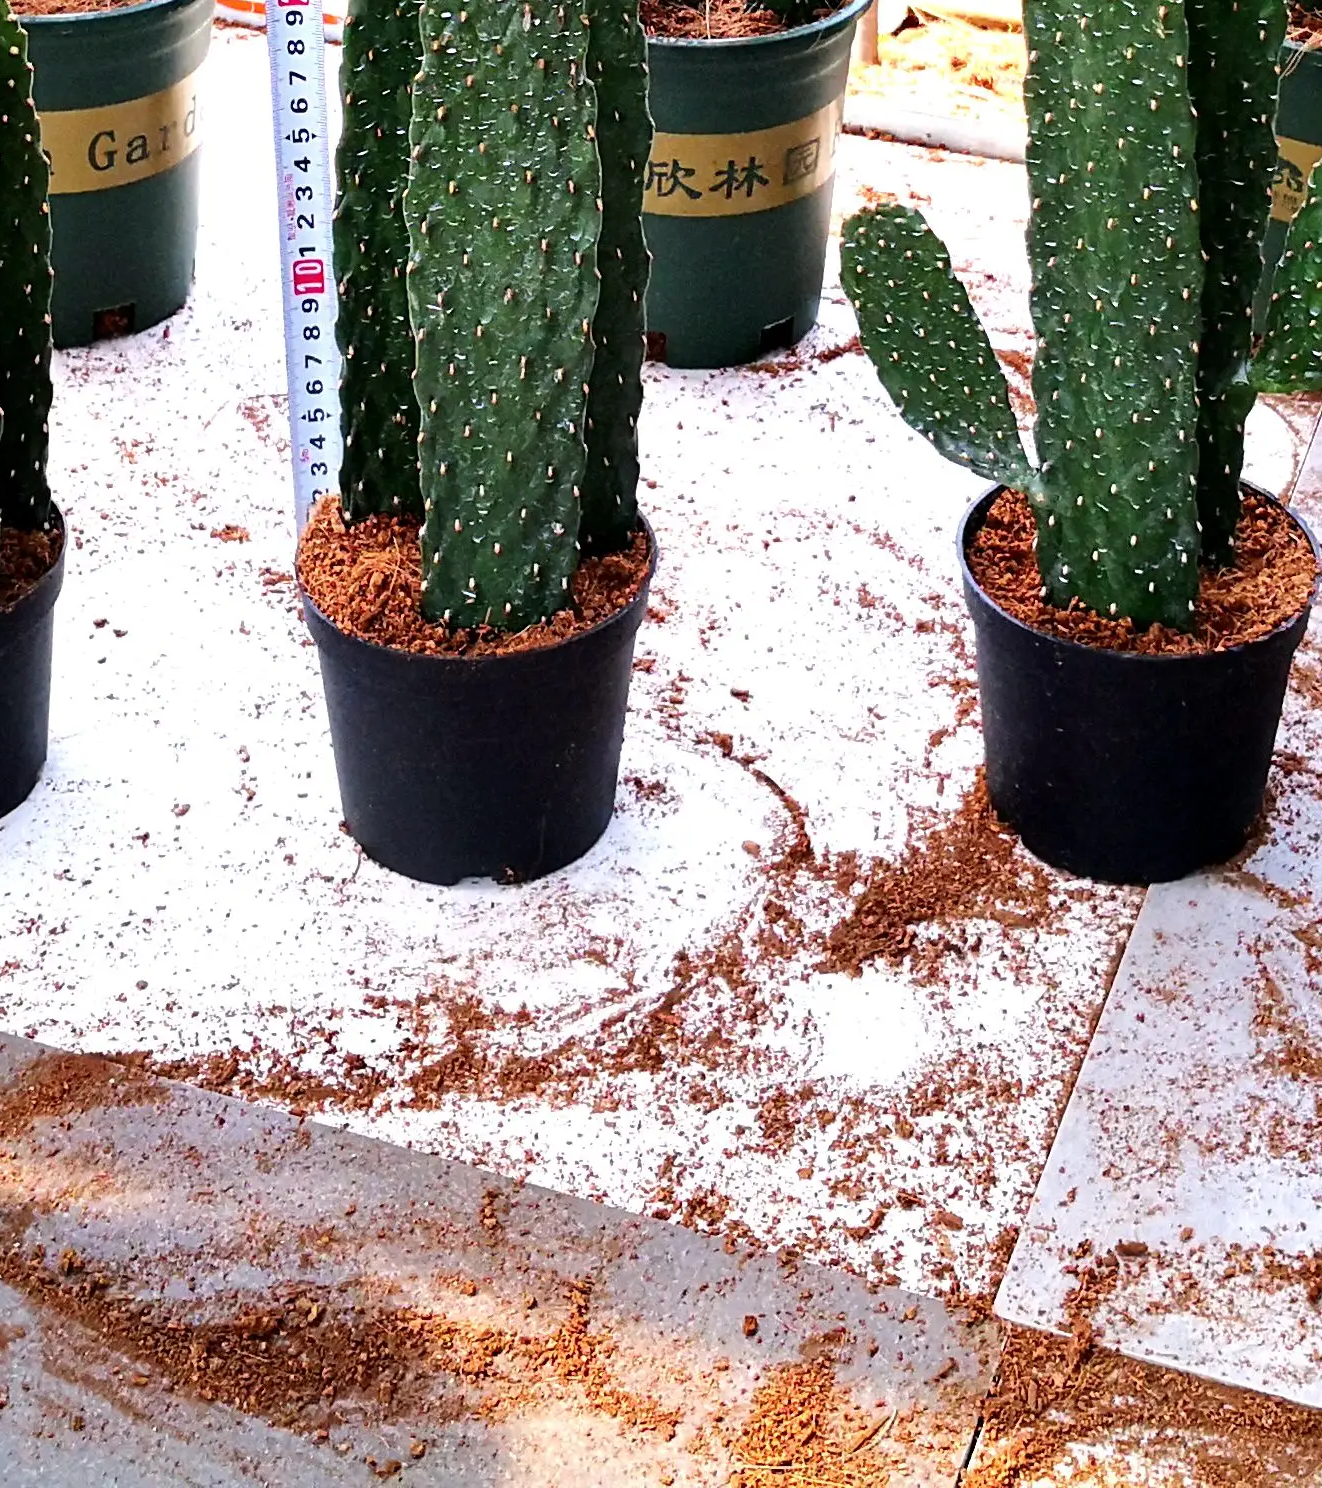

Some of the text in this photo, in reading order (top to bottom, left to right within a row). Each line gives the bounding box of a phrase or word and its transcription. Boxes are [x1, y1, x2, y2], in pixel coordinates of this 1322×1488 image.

[285, 10, 304, 27] 9
[286, 39, 305, 56] 8
[288, 70, 307, 86] 7
[290, 97, 309, 114] 6
[291, 128, 310, 144] 5
[293, 156, 311, 173] 4
[295, 185, 313, 201] 3
[296, 213, 315, 230] 2
[298, 246, 316, 258] 1
[294, 263, 324, 292] 10
[301, 298, 319, 313] 9
[302, 325, 321, 341] 8
[304, 354, 322, 369] 7
[305, 379, 324, 395] 6
[307, 408, 325, 423] 5
[309, 434, 326, 450] 4
[310, 462, 328, 476] 3
